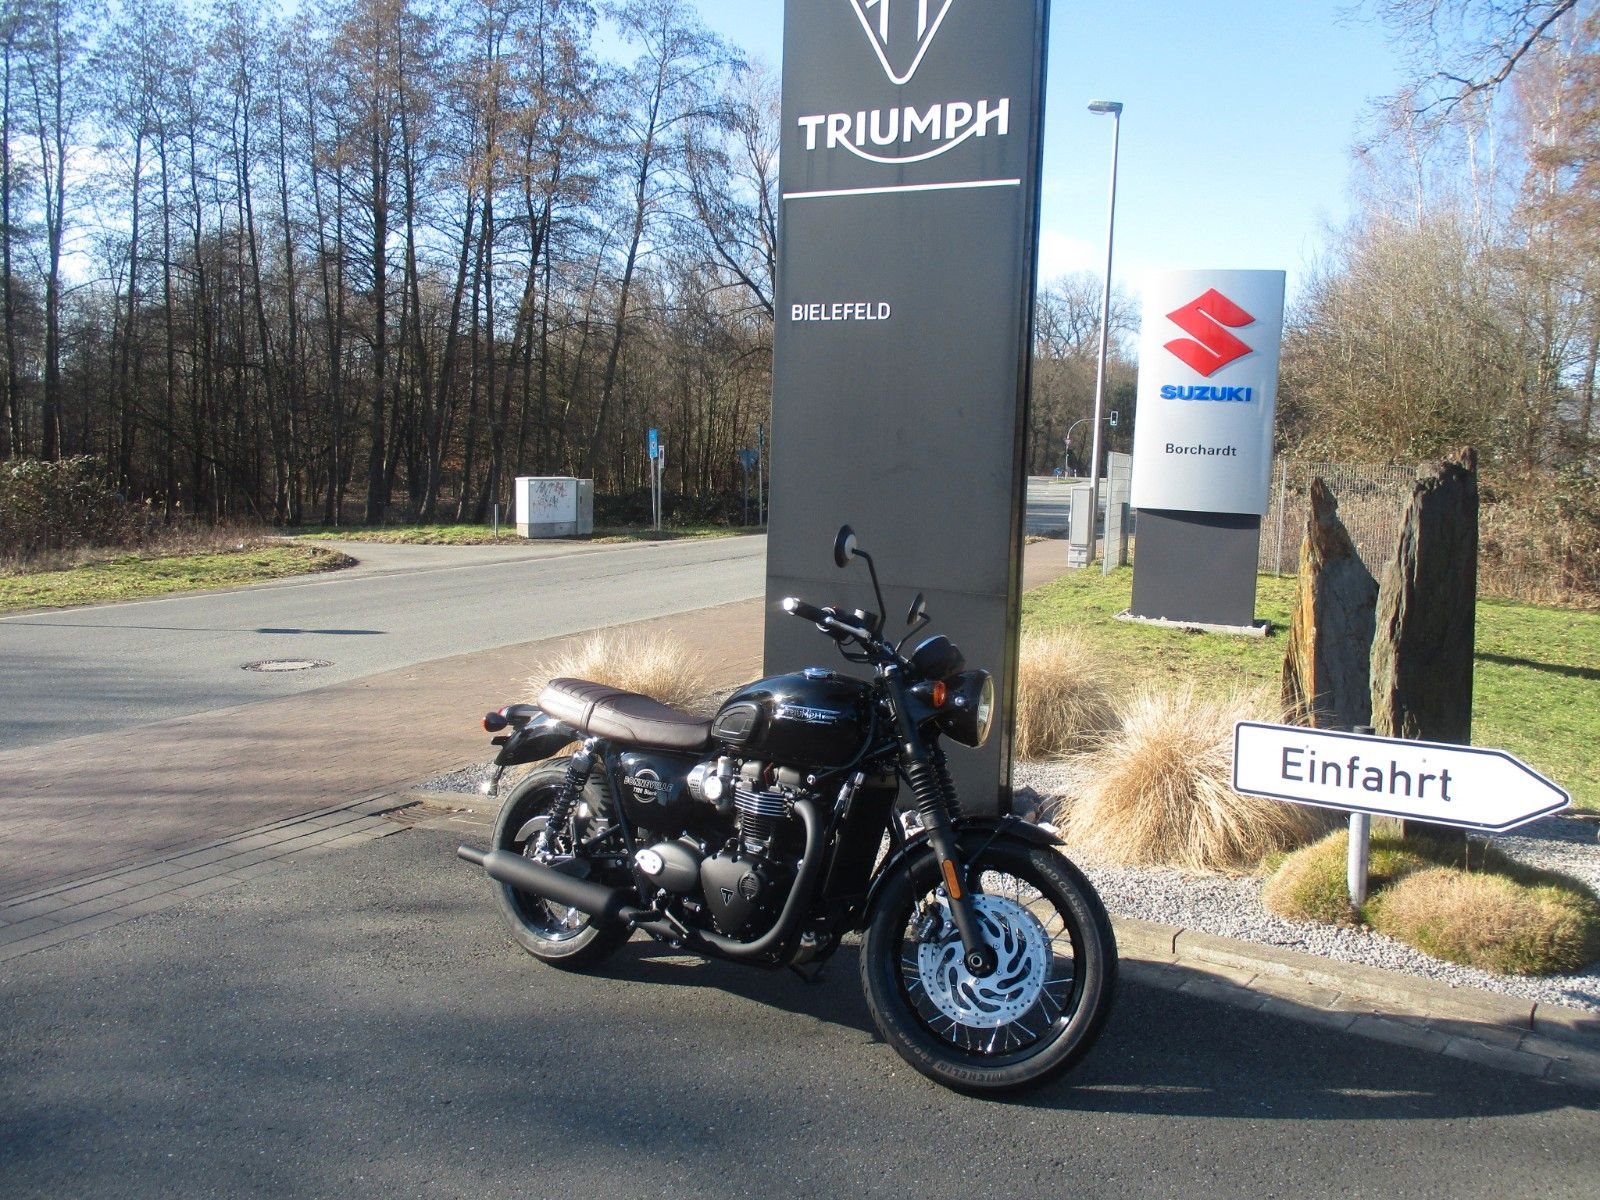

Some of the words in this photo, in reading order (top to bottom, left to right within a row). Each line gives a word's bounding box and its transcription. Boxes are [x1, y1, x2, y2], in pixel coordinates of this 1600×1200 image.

[798, 98, 1009, 163] TRIUMPH
[791, 302, 891, 321] BIELEFELD
[1160, 384, 1252, 402] SUZUKI
[1165, 443, 1237, 457] Borchardt
[1281, 746, 1452, 802] Einfahrt
